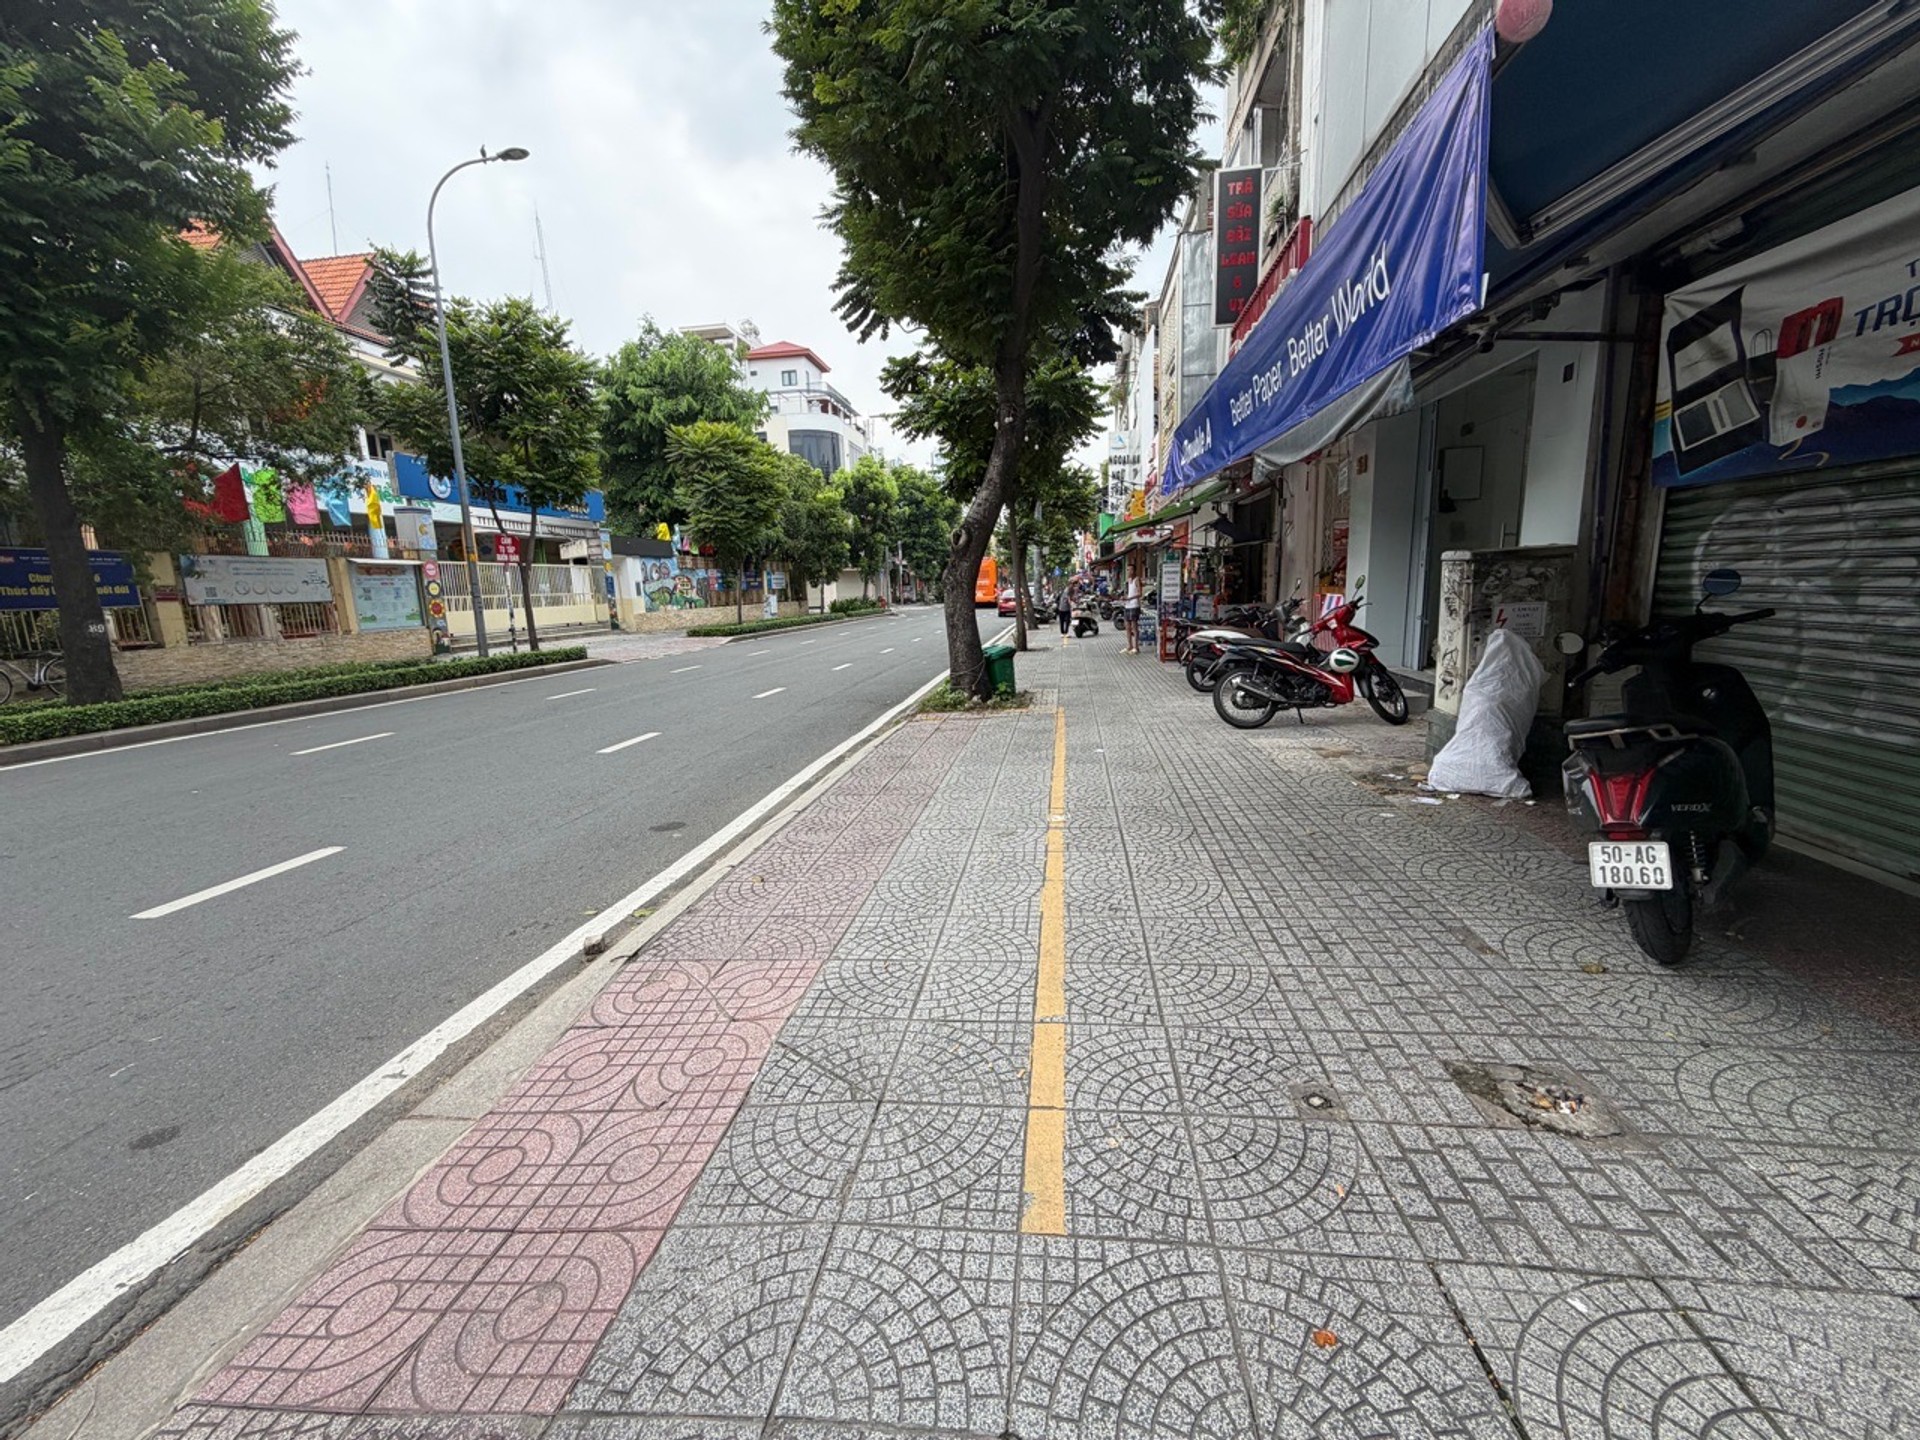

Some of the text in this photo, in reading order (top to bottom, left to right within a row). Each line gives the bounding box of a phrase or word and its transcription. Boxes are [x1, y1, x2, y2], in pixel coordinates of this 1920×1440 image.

[1229, 388, 1254, 427] Better
[1252, 360, 1283, 407] Paper
[1287, 314, 1329, 378] Better
[1331, 241, 1391, 336] World
[1600, 846, 1657, 864] 50-AG
[1599, 865, 1665, 885] 180.60
